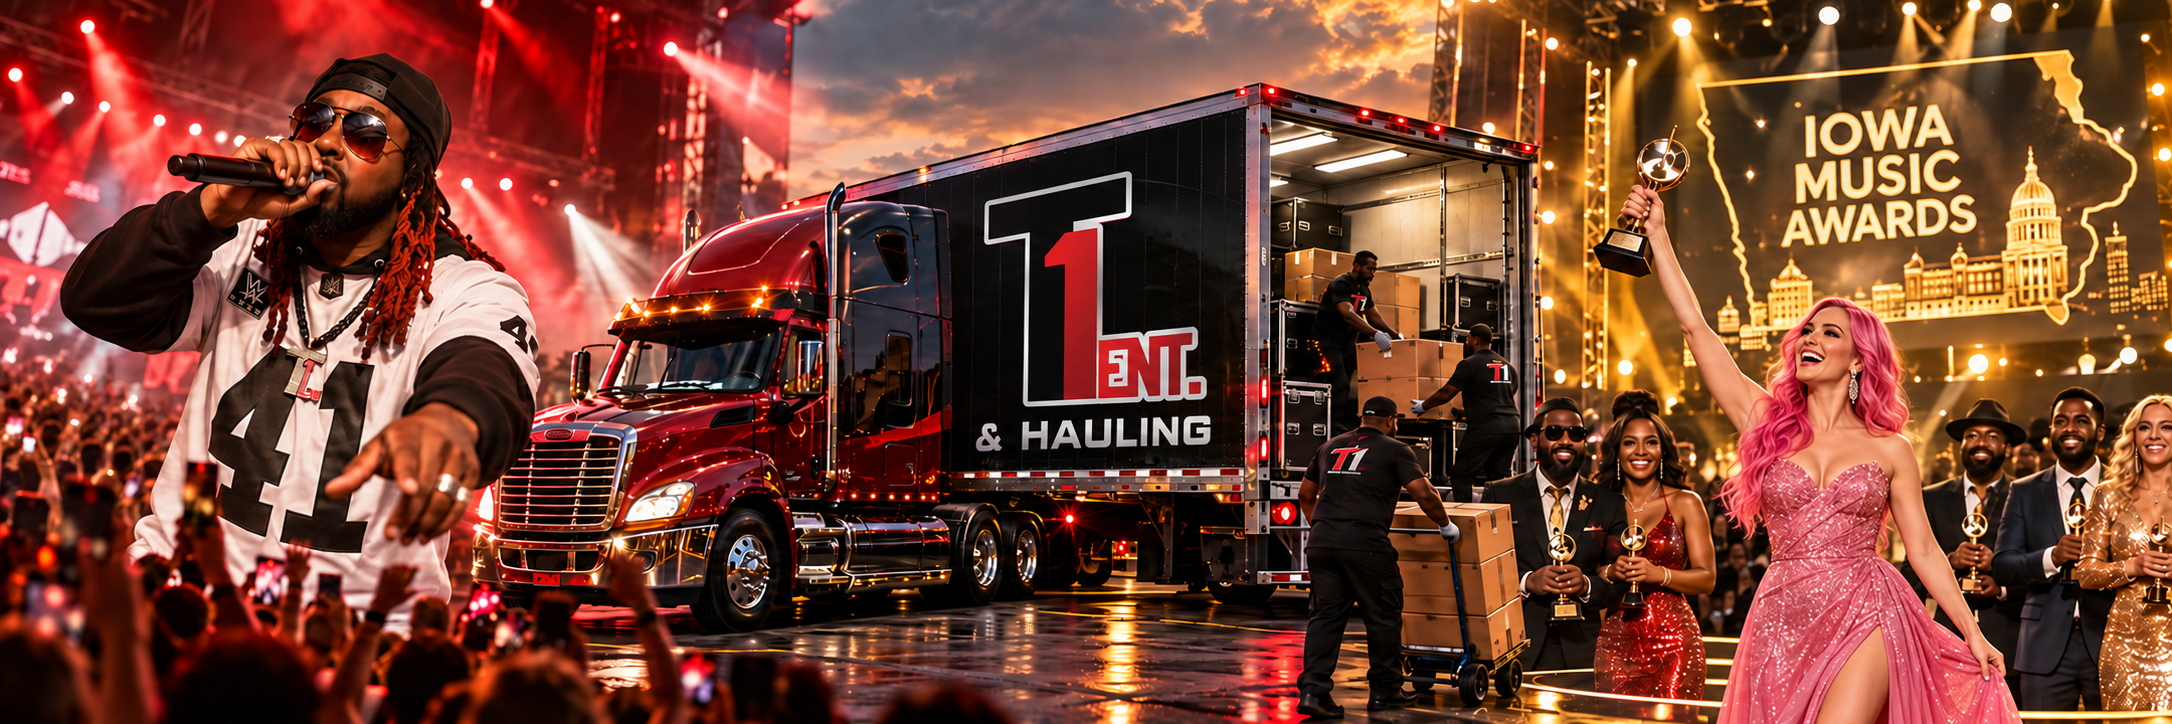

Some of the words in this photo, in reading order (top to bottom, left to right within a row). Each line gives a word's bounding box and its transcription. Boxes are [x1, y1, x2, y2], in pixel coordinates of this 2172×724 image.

[1804, 104, 1955, 158] IOWA
[1795, 149, 1962, 204] MUSIC
[1780, 194, 1978, 248] AWARDS
[1486, 363, 1509, 381] T1
[208, 345, 375, 554] 41
[975, 422, 1002, 452] &
[1021, 415, 1211, 450] HAULING
[1330, 446, 1369, 471] T1
